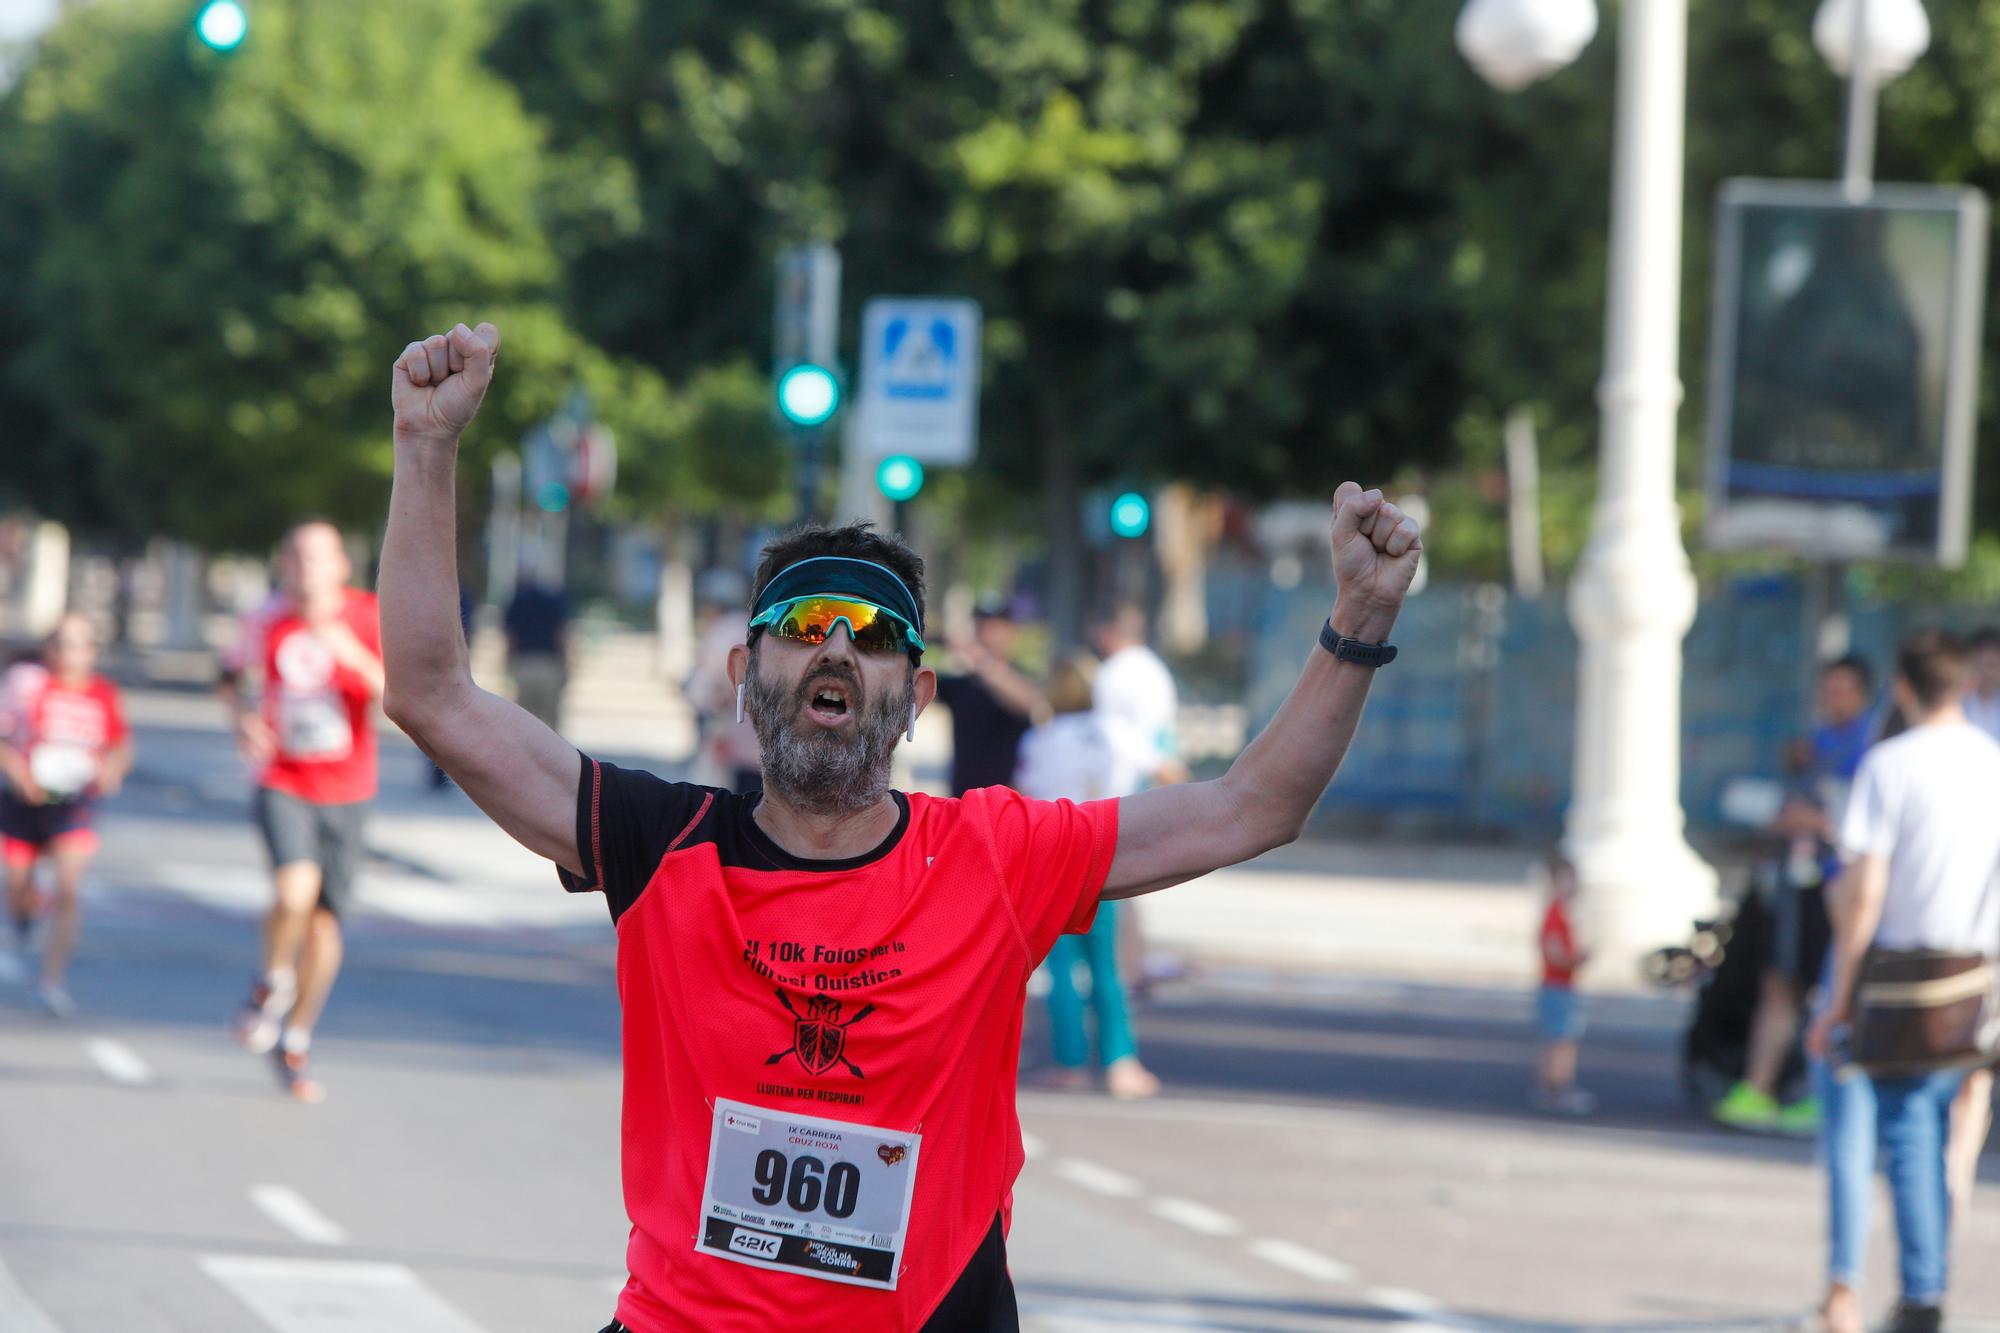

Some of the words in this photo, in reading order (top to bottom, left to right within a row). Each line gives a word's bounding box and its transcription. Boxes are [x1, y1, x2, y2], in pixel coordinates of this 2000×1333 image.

[769, 941, 806, 963] 10k
[813, 945, 869, 963] Foios
[871, 946, 889, 959] per
[892, 941, 905, 953] la
[756, 1082, 794, 1097] LLUITEM
[797, 1088, 814, 1100] PER
[818, 1092, 864, 1105] RESPIRAR!
[788, 1125, 798, 1135] IX
[800, 1127, 842, 1141] CARRERA
[788, 1136, 814, 1147] CRUZ
[815, 1140, 840, 1152] ROJA
[752, 1149, 861, 1219] 960
[769, 1219, 795, 1230] SUPER
[733, 1234, 777, 1254] 42K
